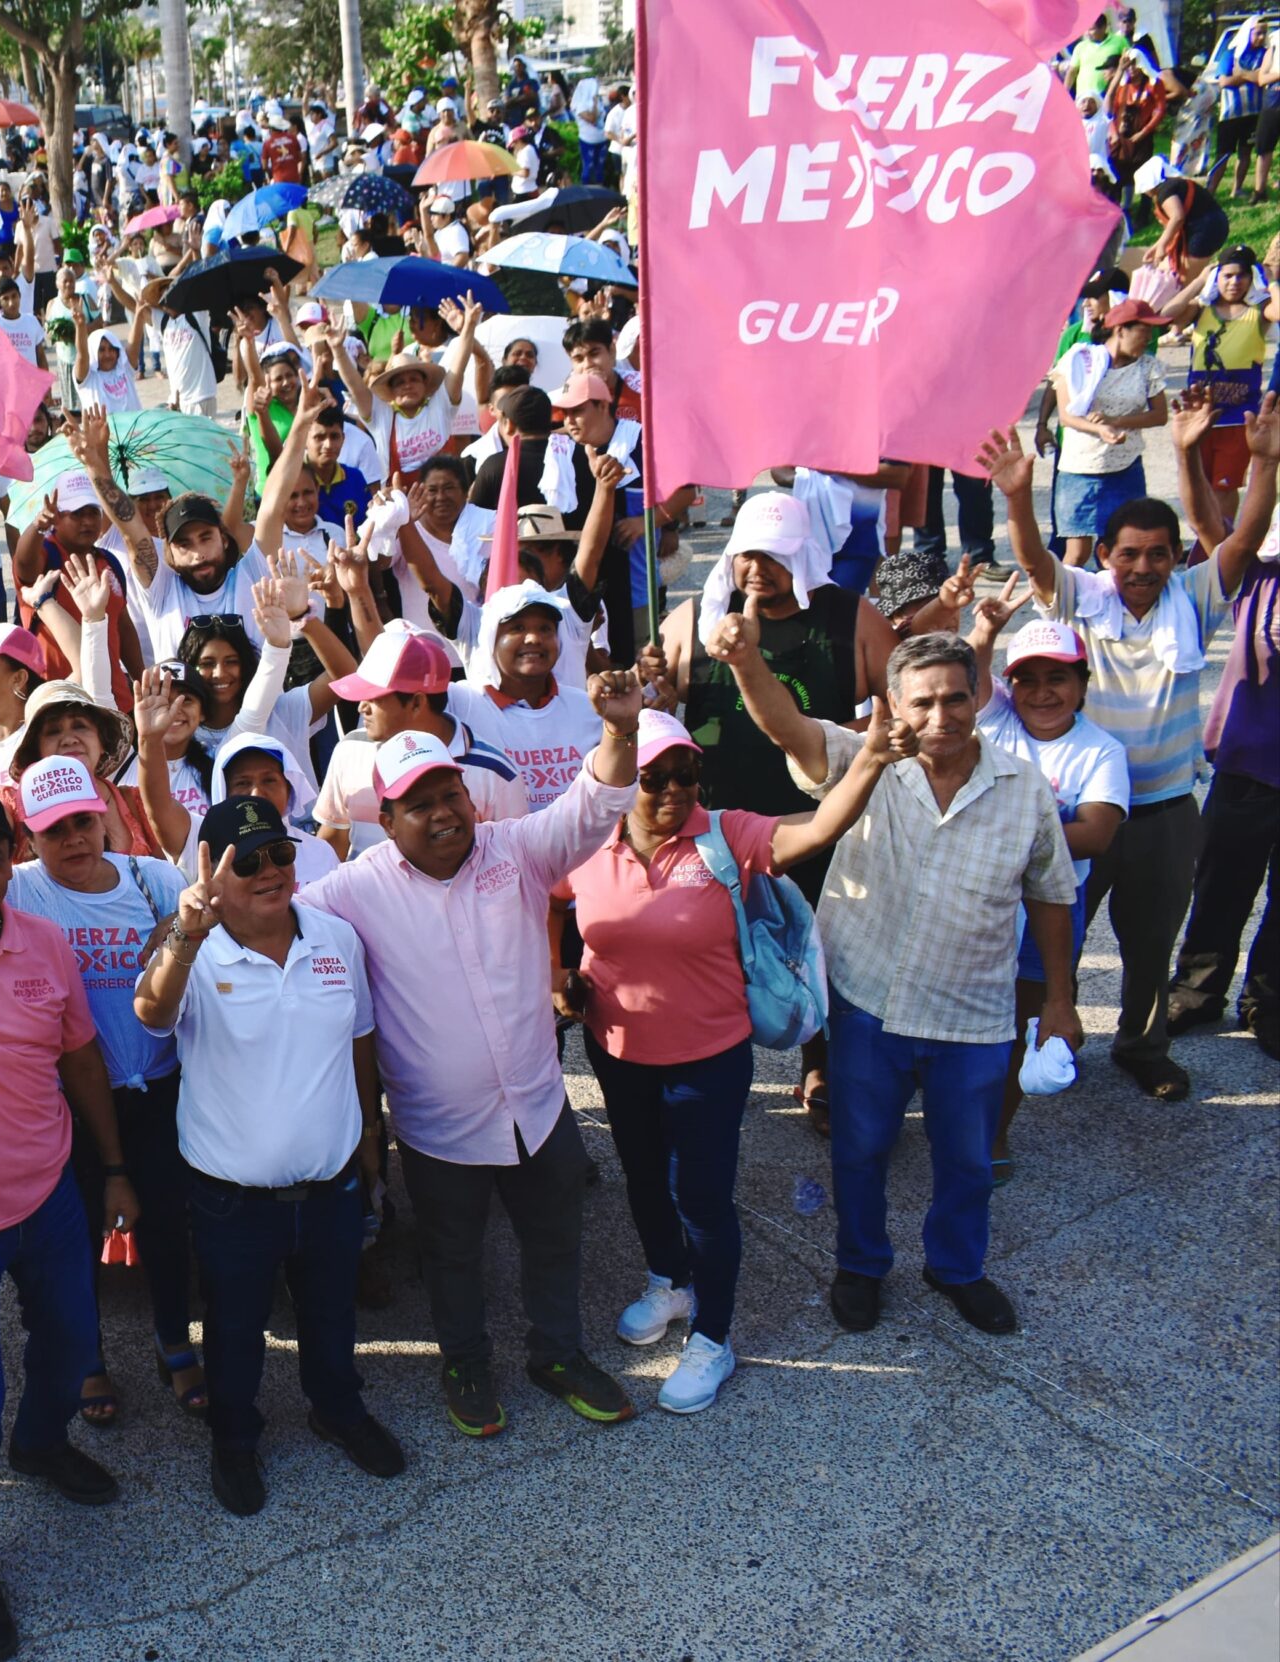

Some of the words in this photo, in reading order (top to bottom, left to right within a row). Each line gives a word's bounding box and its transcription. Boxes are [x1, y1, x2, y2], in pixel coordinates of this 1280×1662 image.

[748, 35, 1052, 134] FUERZA
[688, 146, 1037, 230] MEXICO
[31, 776, 83, 796] MEXICO
[33, 767, 77, 785] FUERZA
[36, 785, 82, 802] GUERRERO
[475, 867, 519, 894] MEXICO
[476, 860, 511, 883] FUERZA
[61, 926, 142, 946] UERZA
[312, 957, 341, 966] FUERZA
[312, 965, 346, 975] MEXICO
